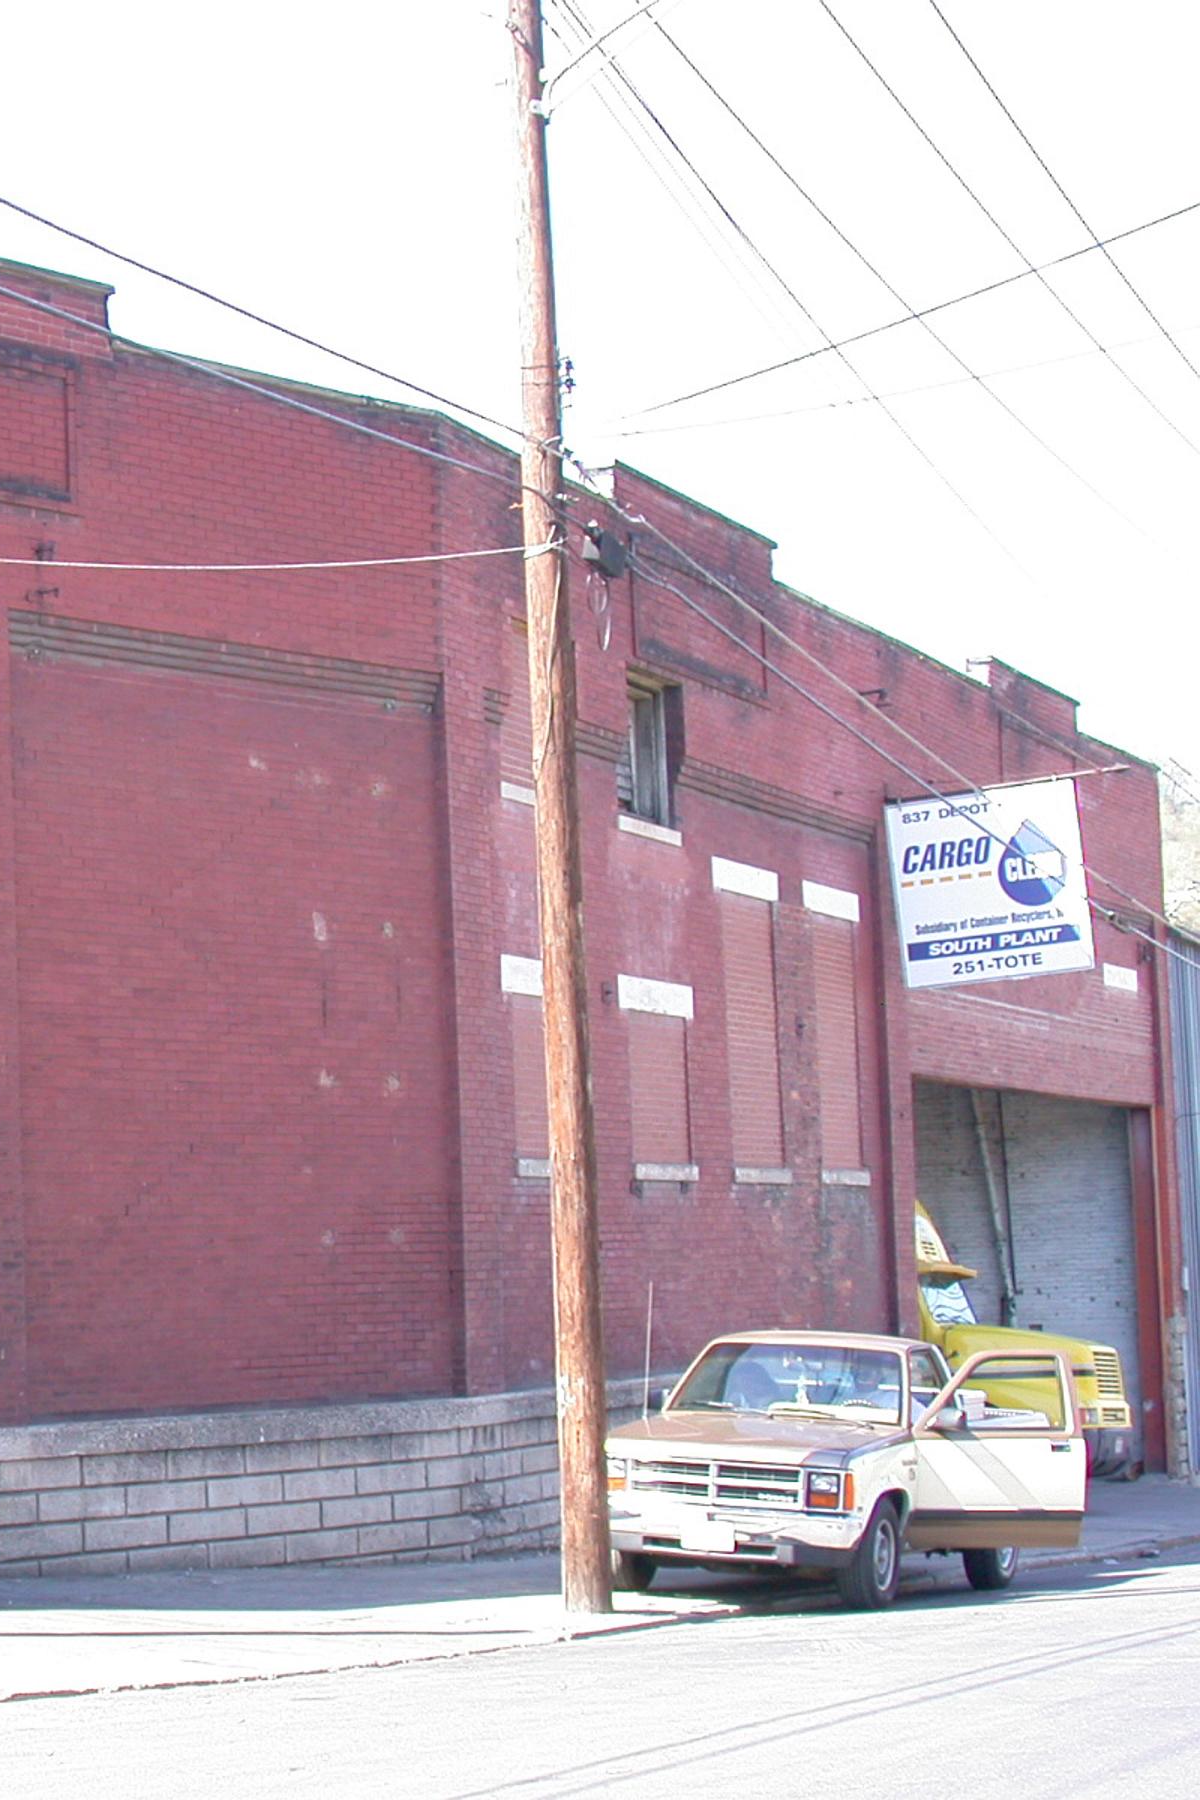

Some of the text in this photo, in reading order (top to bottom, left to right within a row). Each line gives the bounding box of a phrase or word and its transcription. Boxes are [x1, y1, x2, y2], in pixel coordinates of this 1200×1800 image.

[902, 810, 930, 824] 837
[902, 836, 991, 874] CARGO
[929, 928, 1061, 956] SOUTH PLANT
[952, 952, 1043, 975] 251-TOTE
